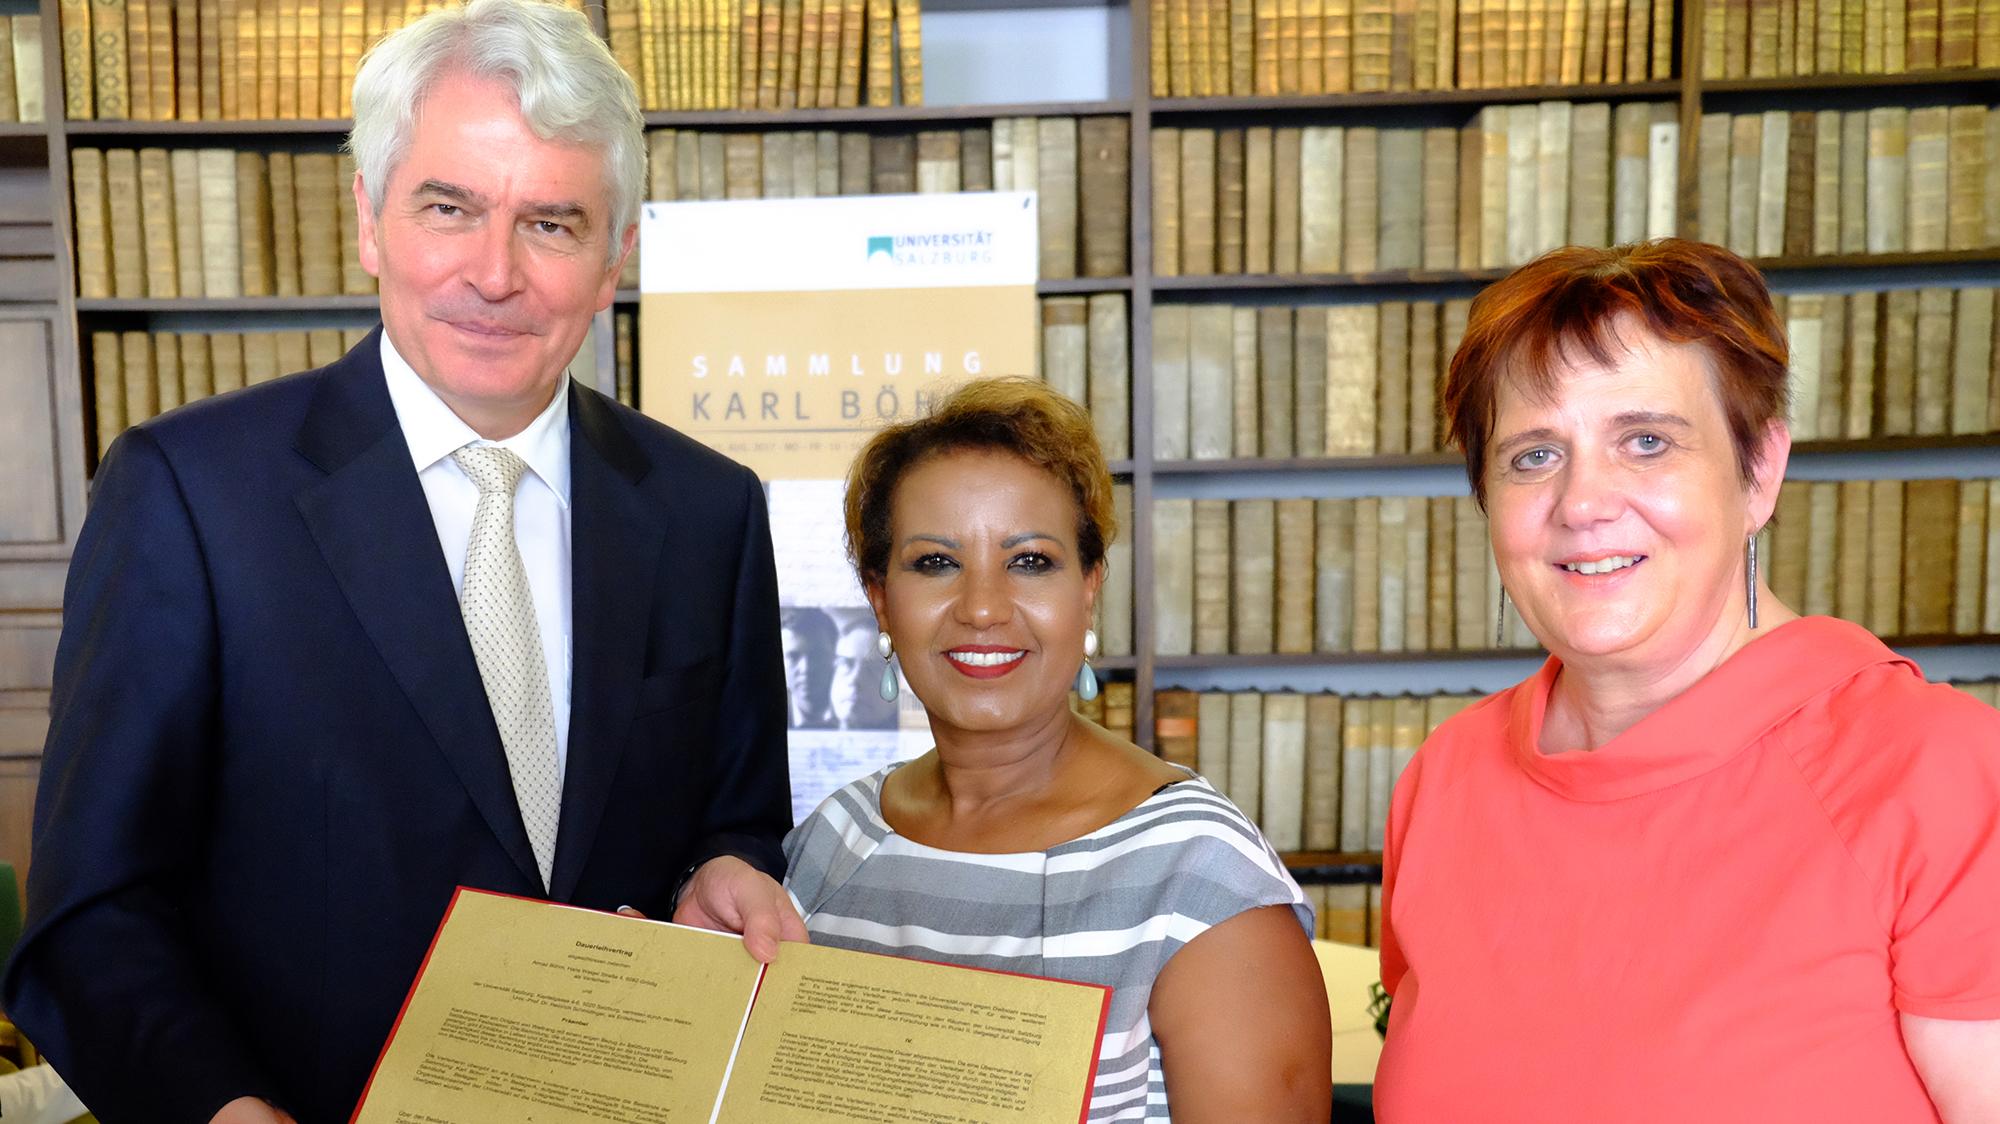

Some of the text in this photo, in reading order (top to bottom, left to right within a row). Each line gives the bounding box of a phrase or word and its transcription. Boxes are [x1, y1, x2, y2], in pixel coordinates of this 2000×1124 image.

[895, 231, 993, 248] UNIVERSITÄT
[895, 250, 993, 265] SALZBURG
[692, 353, 981, 378] SAMMLUNG
[692, 385, 934, 422] KARL BÖH
[574, 940, 633, 957] Dauerleihvertrag
